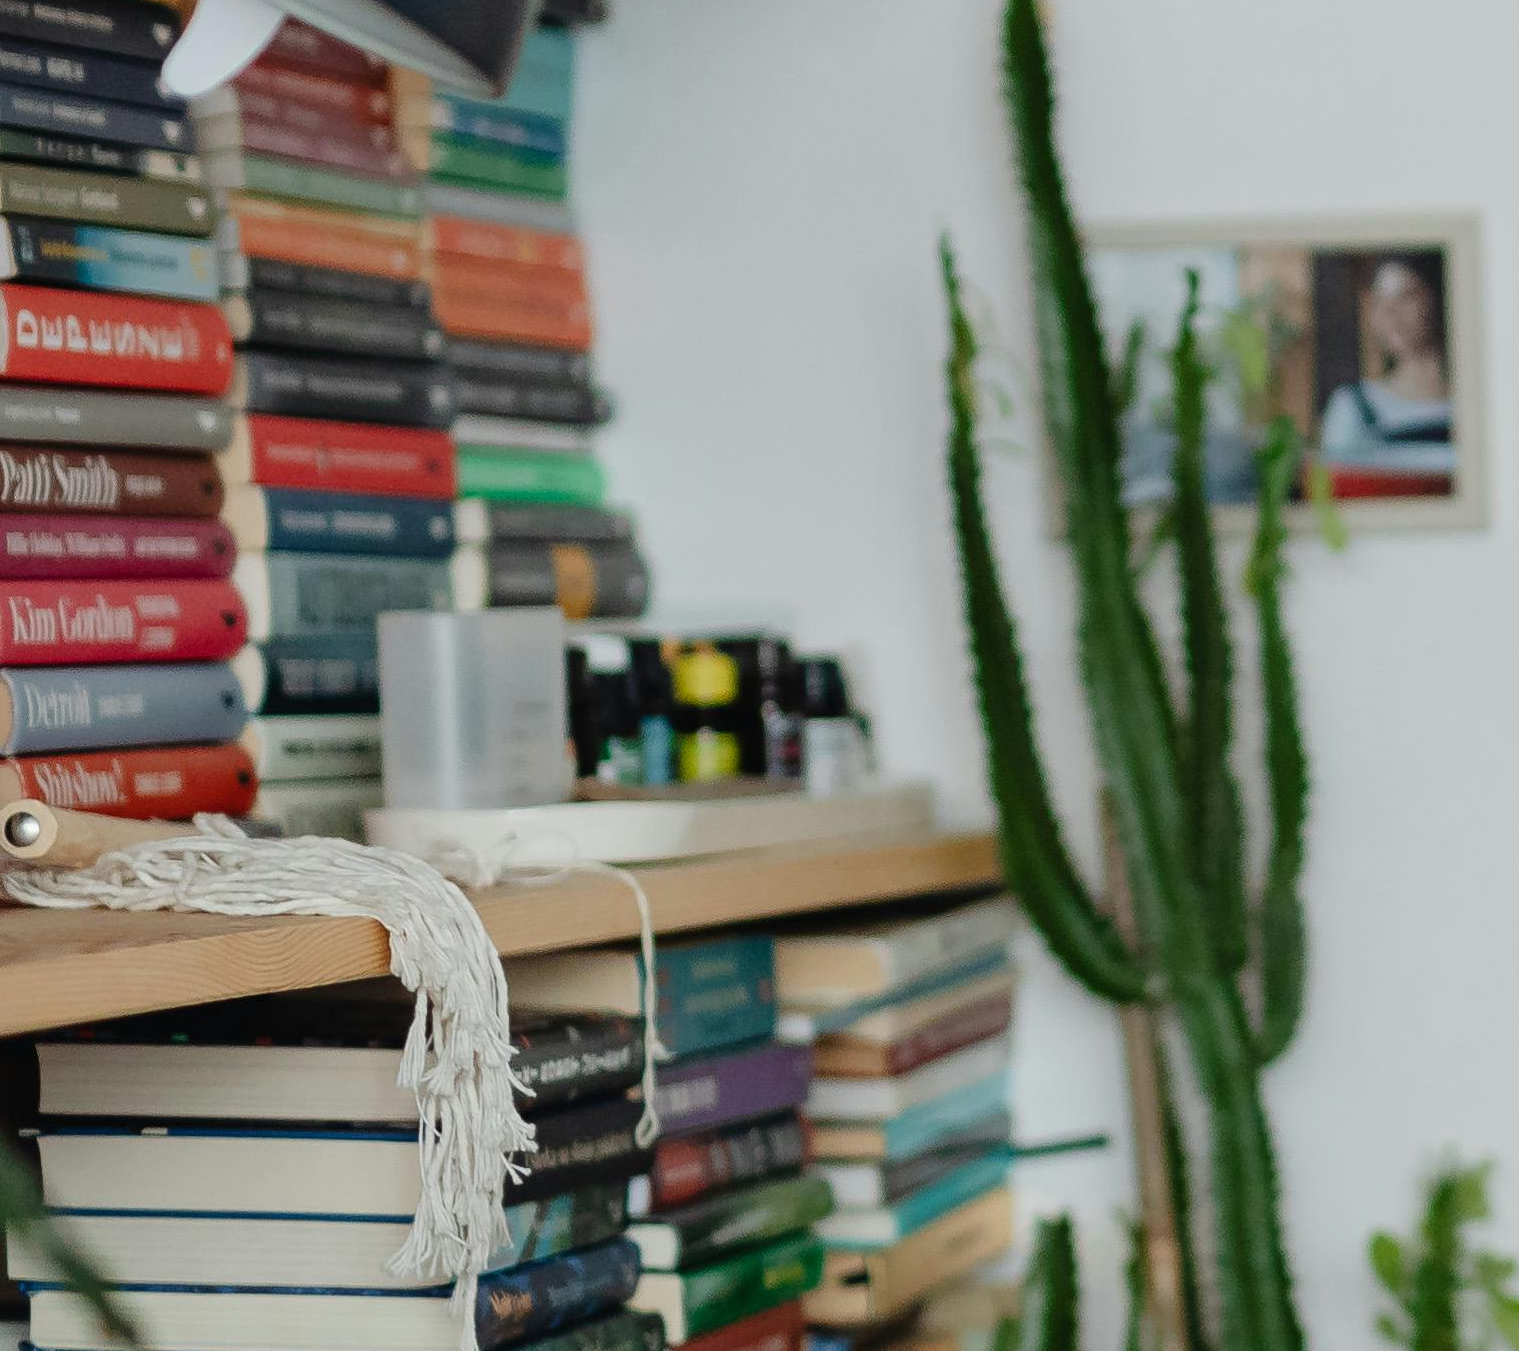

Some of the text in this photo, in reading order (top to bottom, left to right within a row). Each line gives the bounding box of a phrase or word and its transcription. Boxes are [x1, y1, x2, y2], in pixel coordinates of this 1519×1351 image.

[52, 453, 119, 508] Smith
[7, 595, 56, 645] Kim
[57, 593, 134, 644] Gordon
[23, 679, 91, 729] Detroit
[32, 756, 128, 807] Shitshow!
